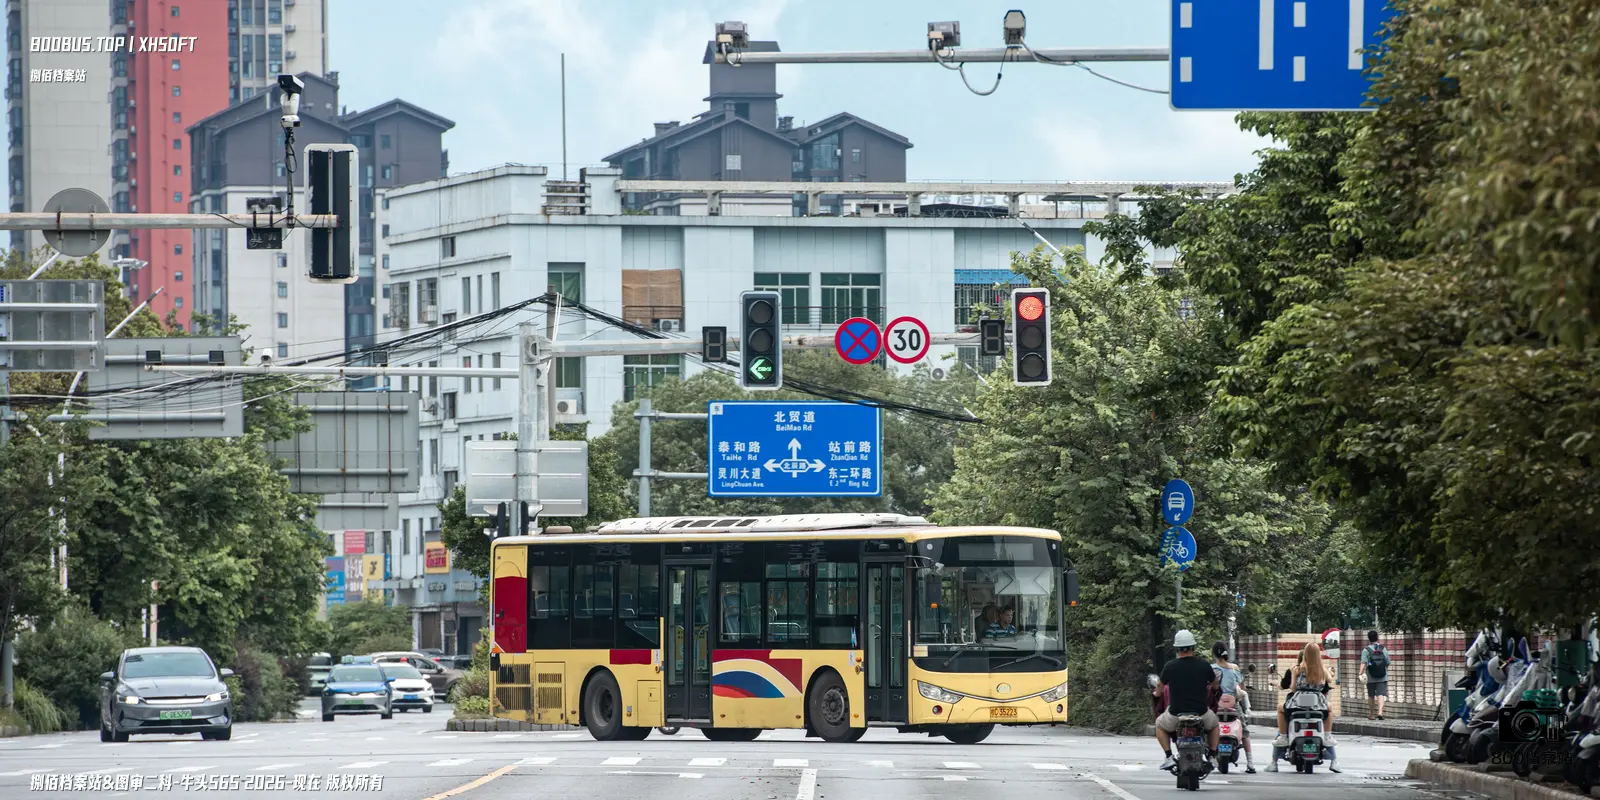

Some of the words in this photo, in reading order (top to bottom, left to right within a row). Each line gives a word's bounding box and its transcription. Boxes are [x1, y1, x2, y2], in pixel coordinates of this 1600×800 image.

[893, 329, 921, 351] 30
[774, 411, 815, 423] 北贸道
[775, 424, 802, 432] BeiMao
[718, 441, 761, 453] 泰和路
[828, 441, 871, 453] 站前路
[831, 453, 858, 461] ZhanQian
[718, 467, 761, 480] 灵川大道
[828, 467, 872, 480] 东二环路
[721, 480, 752, 488] LingChuan
[848, 480, 860, 488] Ring
